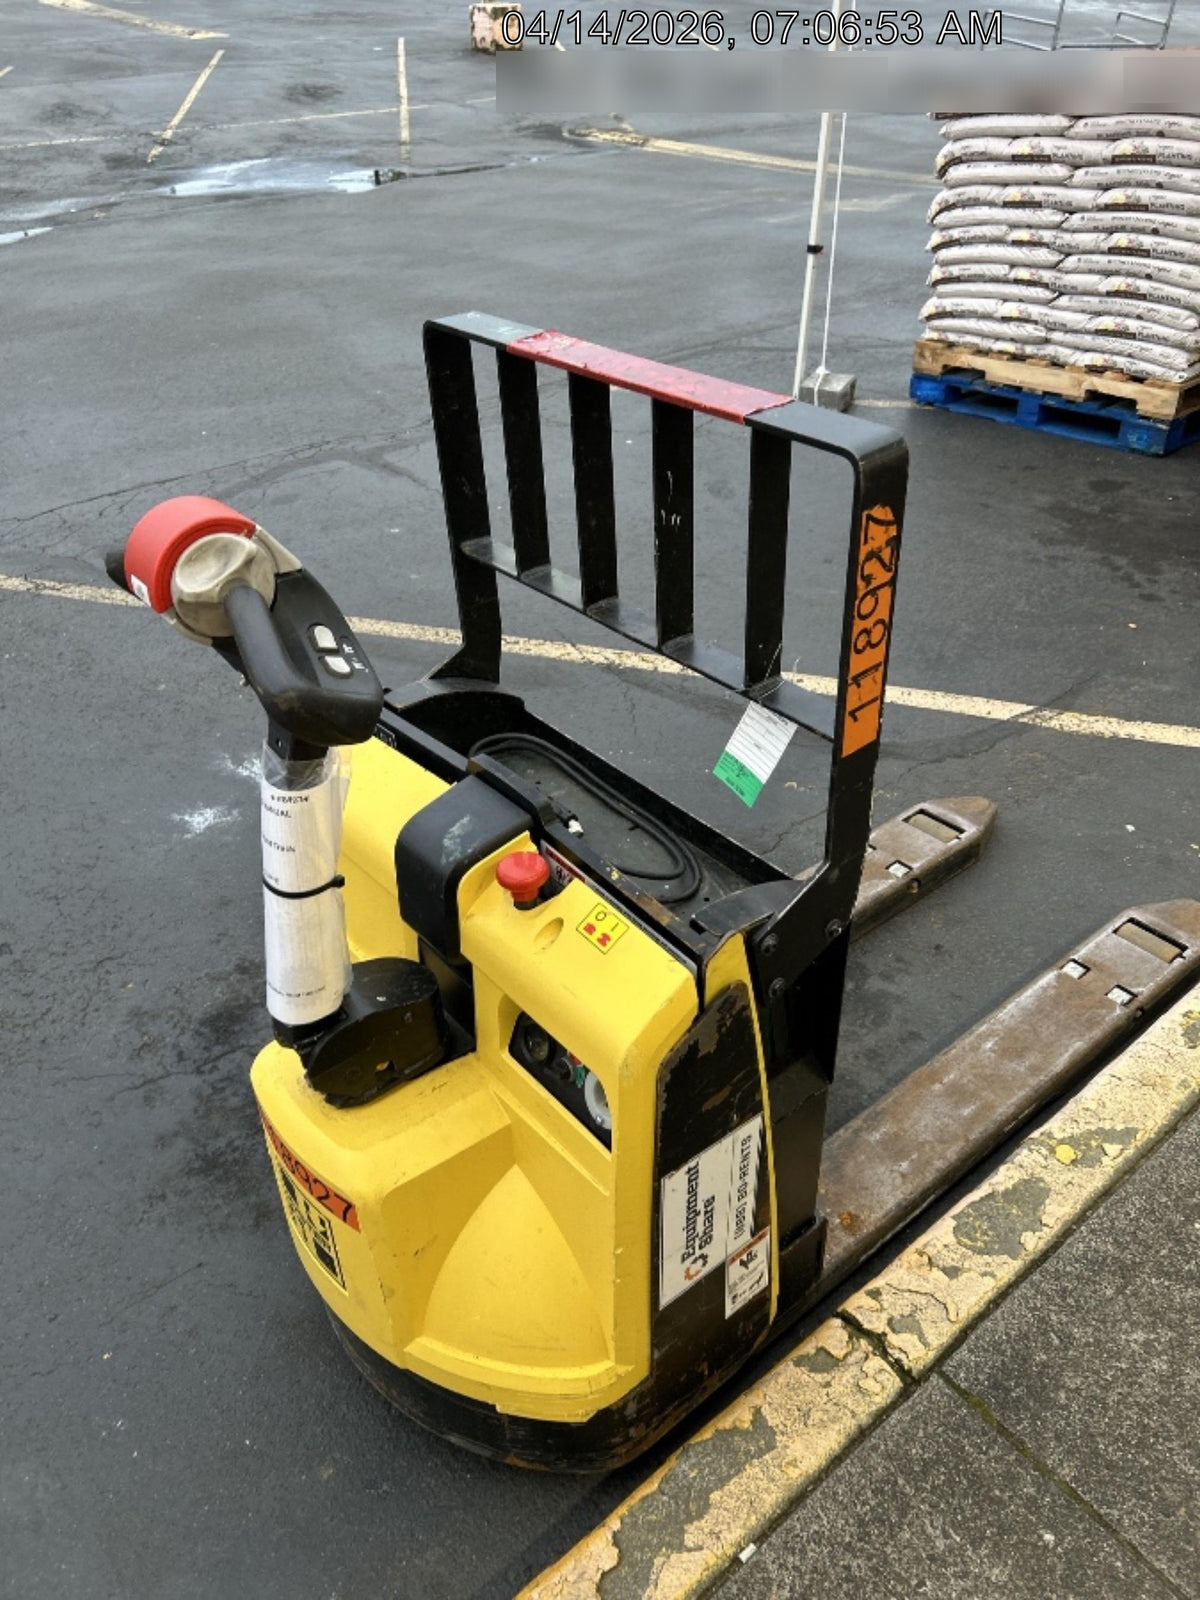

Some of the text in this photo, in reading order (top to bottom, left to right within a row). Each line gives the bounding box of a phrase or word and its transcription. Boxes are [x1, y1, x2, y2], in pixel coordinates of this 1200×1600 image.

[848, 511, 898, 723] 118927
[681, 1160, 699, 1264] Equipment
[699, 1194, 715, 1250] Share
